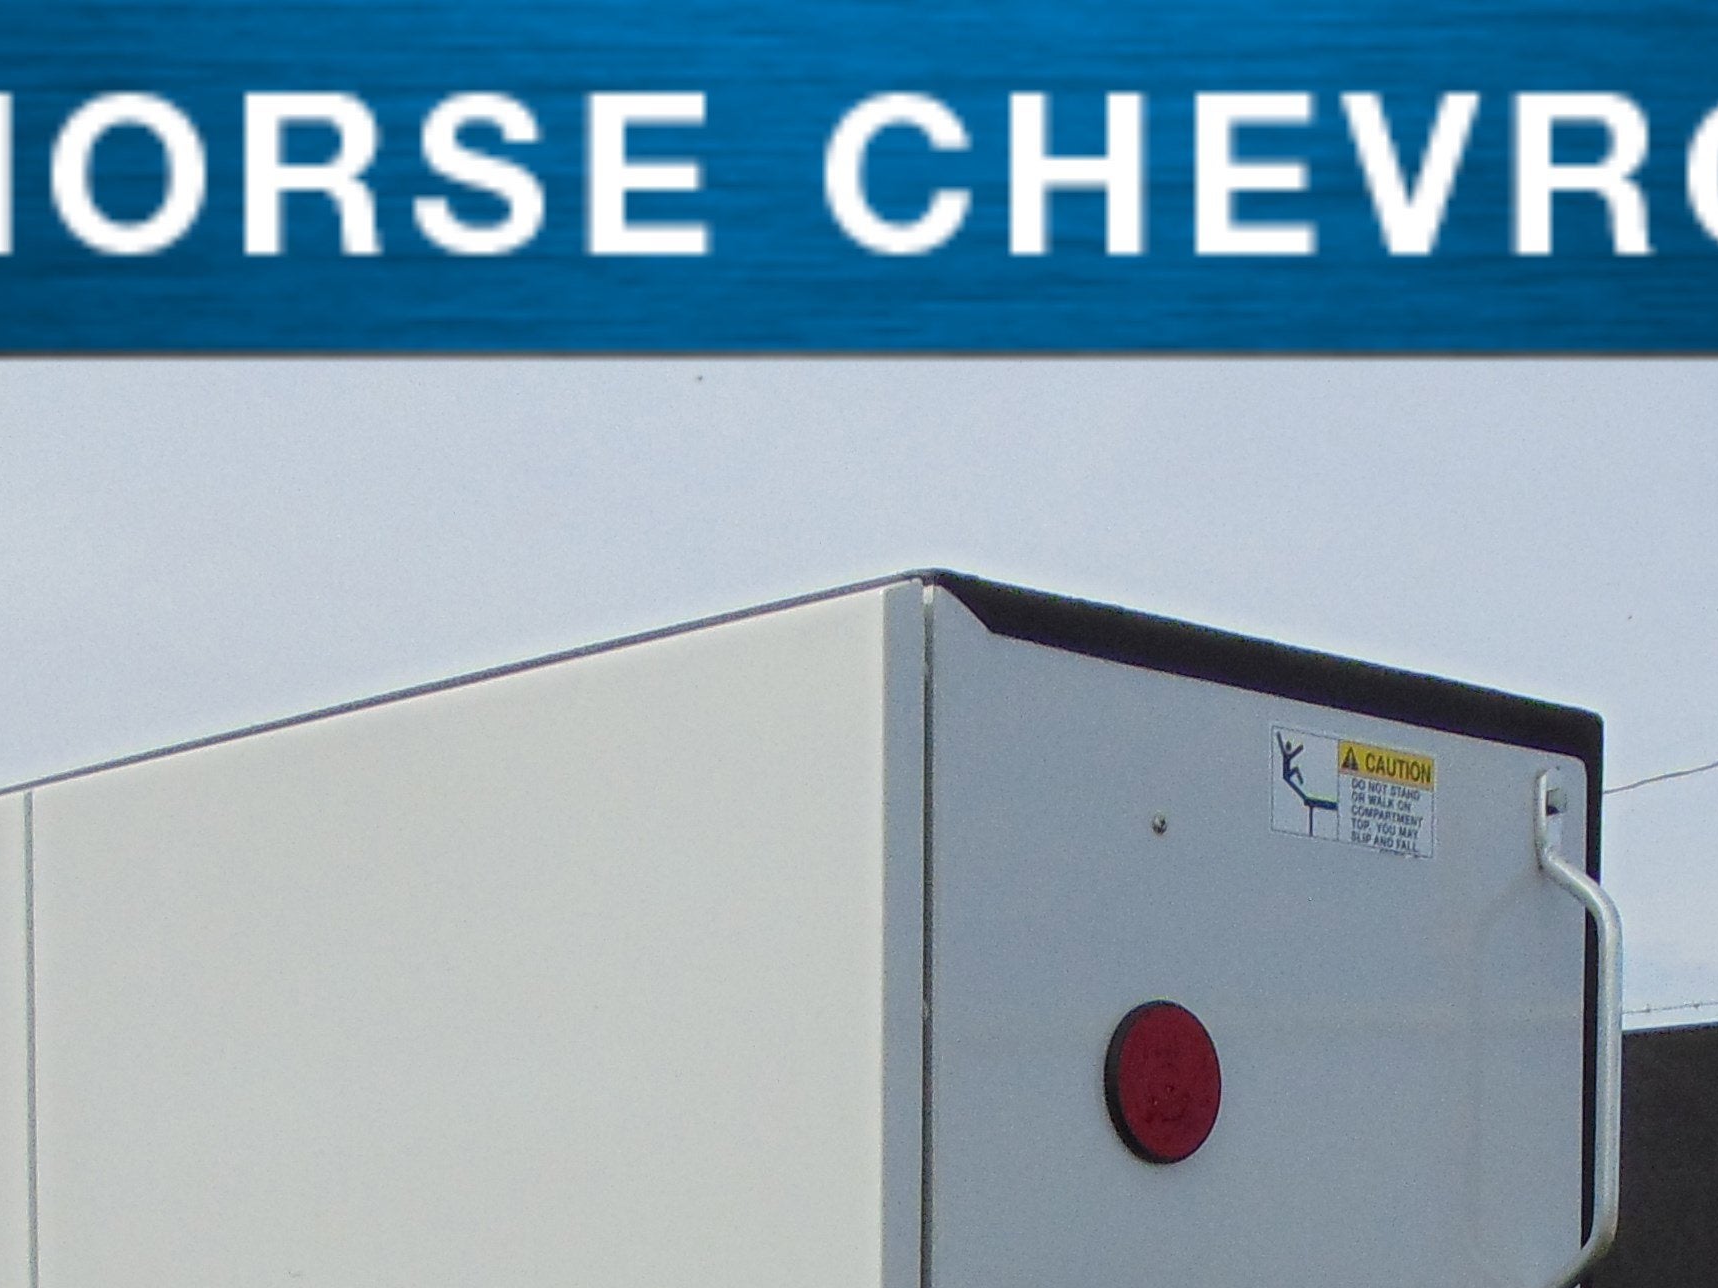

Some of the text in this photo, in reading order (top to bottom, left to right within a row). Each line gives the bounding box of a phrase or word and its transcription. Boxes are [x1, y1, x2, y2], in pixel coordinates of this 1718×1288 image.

[1365, 752, 1431, 783] CAUTION
[1352, 778, 1365, 790] DO
[1368, 782, 1387, 793] NOT
[1351, 791, 1412, 812] OR WALK ON
[1351, 805, 1423, 828] COMPARTMENT
[1351, 831, 1371, 843] SLIP
[1374, 835, 1394, 847] AND
[1377, 824, 1396, 835] YOU
[1399, 828, 1419, 839] MAY
